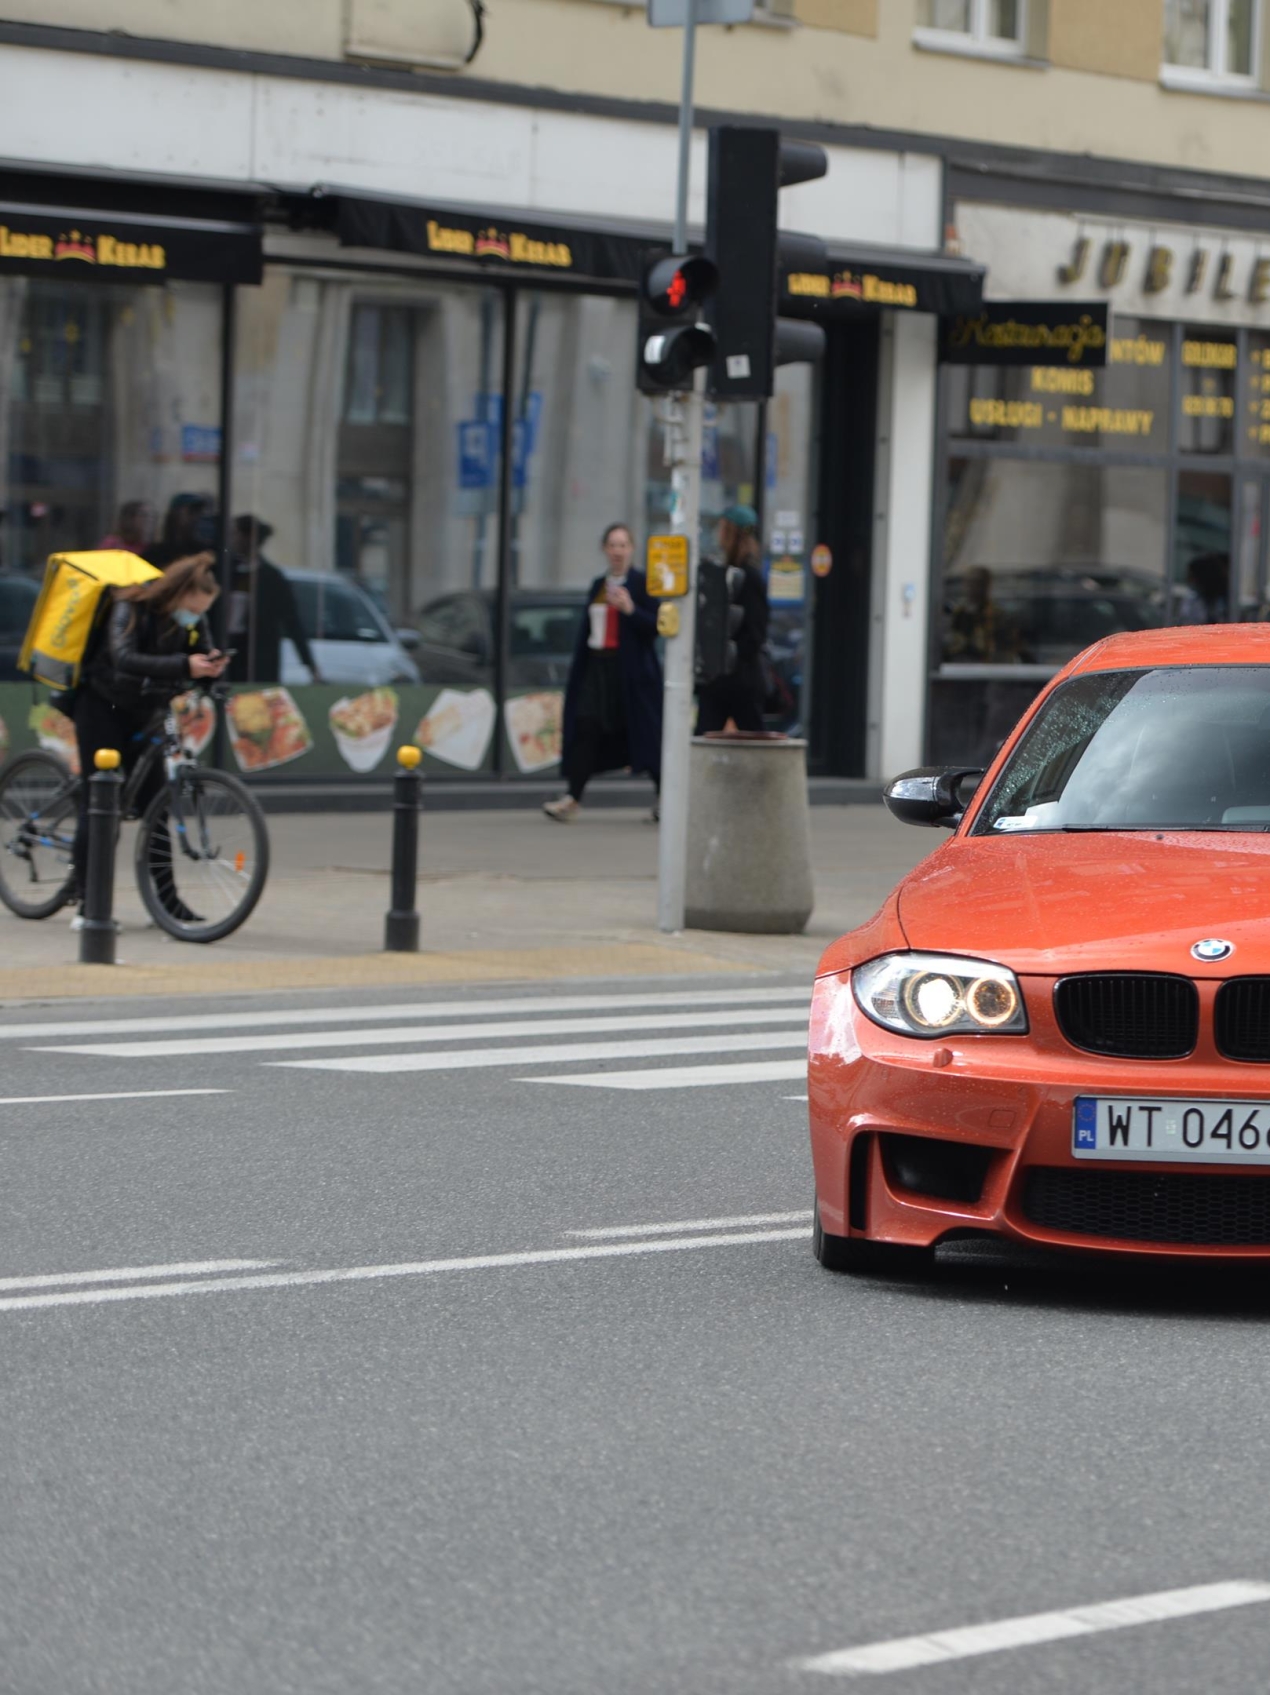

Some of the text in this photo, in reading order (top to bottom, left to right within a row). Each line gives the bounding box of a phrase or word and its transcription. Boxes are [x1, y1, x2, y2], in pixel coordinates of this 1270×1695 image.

[1031, 366, 1094, 396] KOMIS
[1078, 1129, 1094, 1142] PL
[1108, 1104, 1163, 1147] WT
